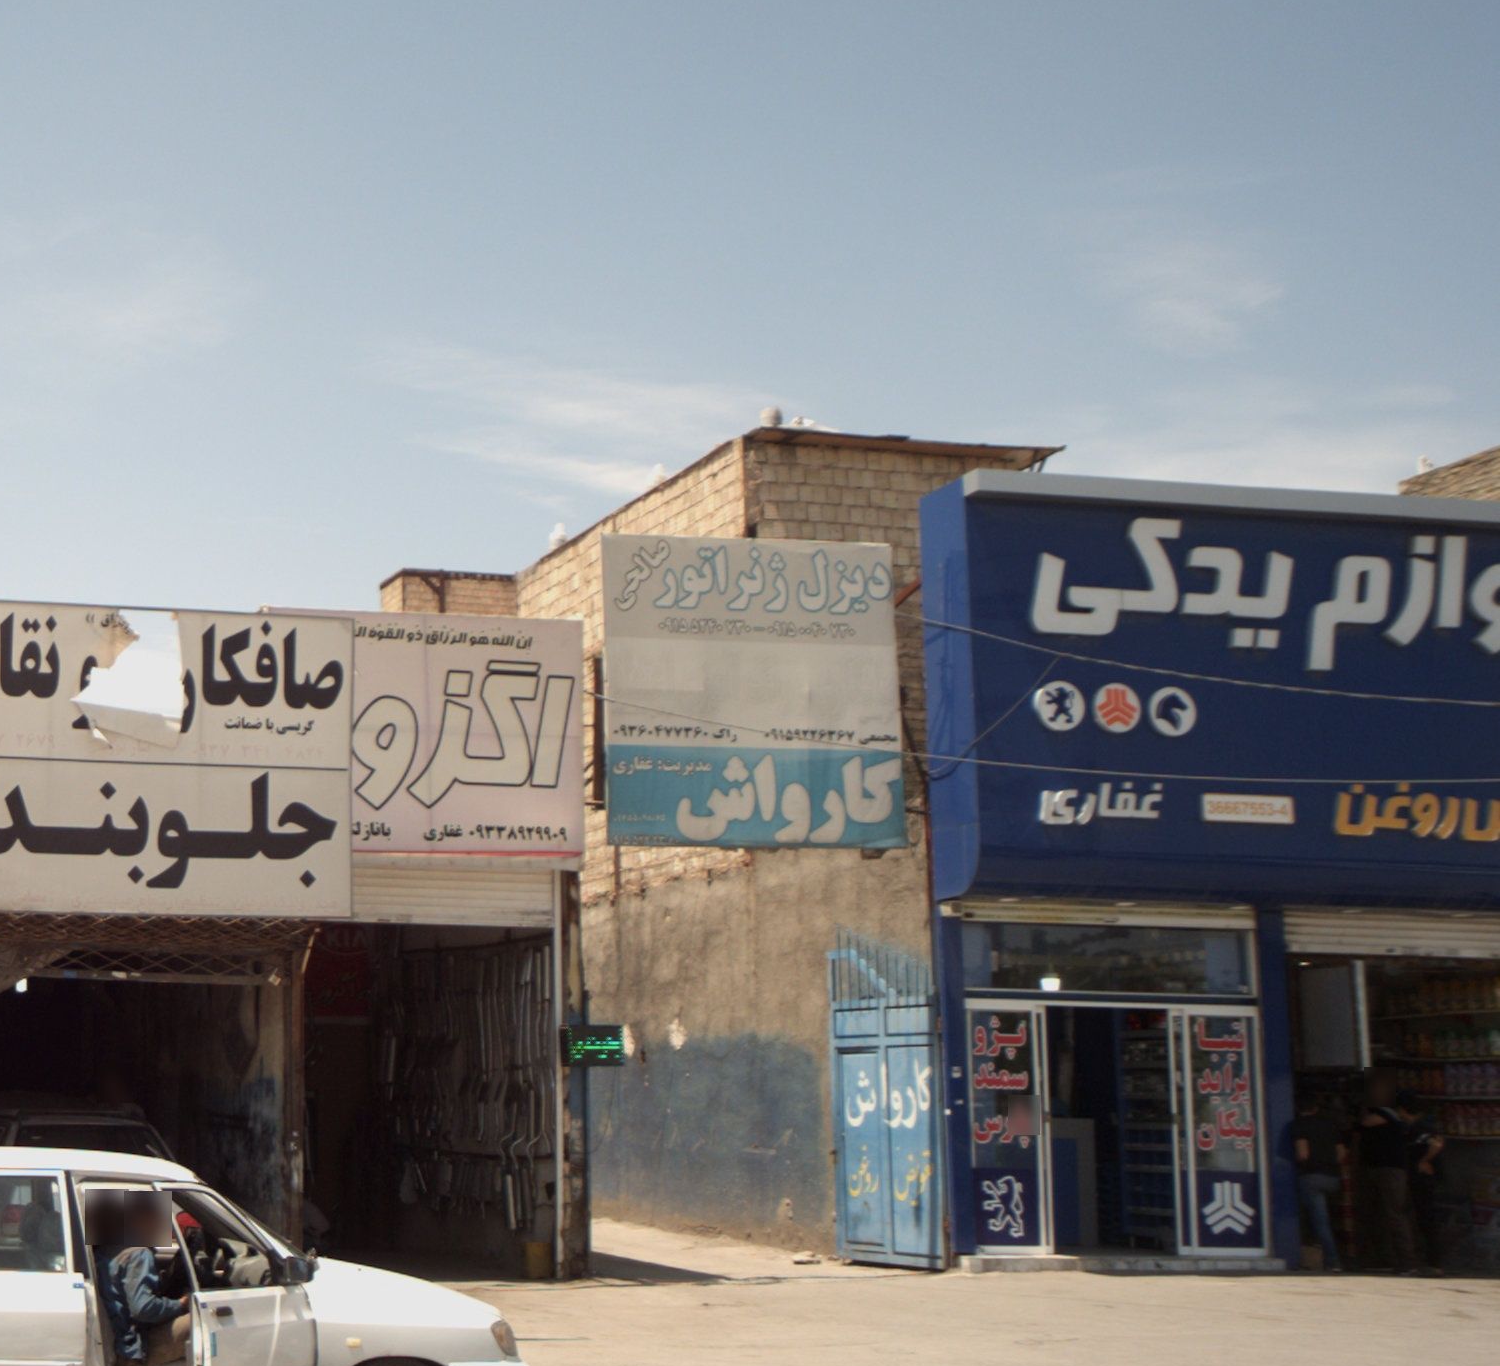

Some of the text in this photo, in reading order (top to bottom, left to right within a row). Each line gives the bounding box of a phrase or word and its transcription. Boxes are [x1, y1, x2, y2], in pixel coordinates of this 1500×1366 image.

[654, 544, 892, 616] دیزل ژنراتور
[1031, 517, 1294, 650] یدکی
[352, 660, 575, 811] اگزو
[676, 754, 901, 844] کارواش
[1039, 782, 1164, 825] غفاری
[1334, 782, 1460, 839] روغن
[972, 1015, 1027, 1060] پژو
[846, 1056, 932, 1129] کارواش
[973, 1061, 1029, 1089] سمند
